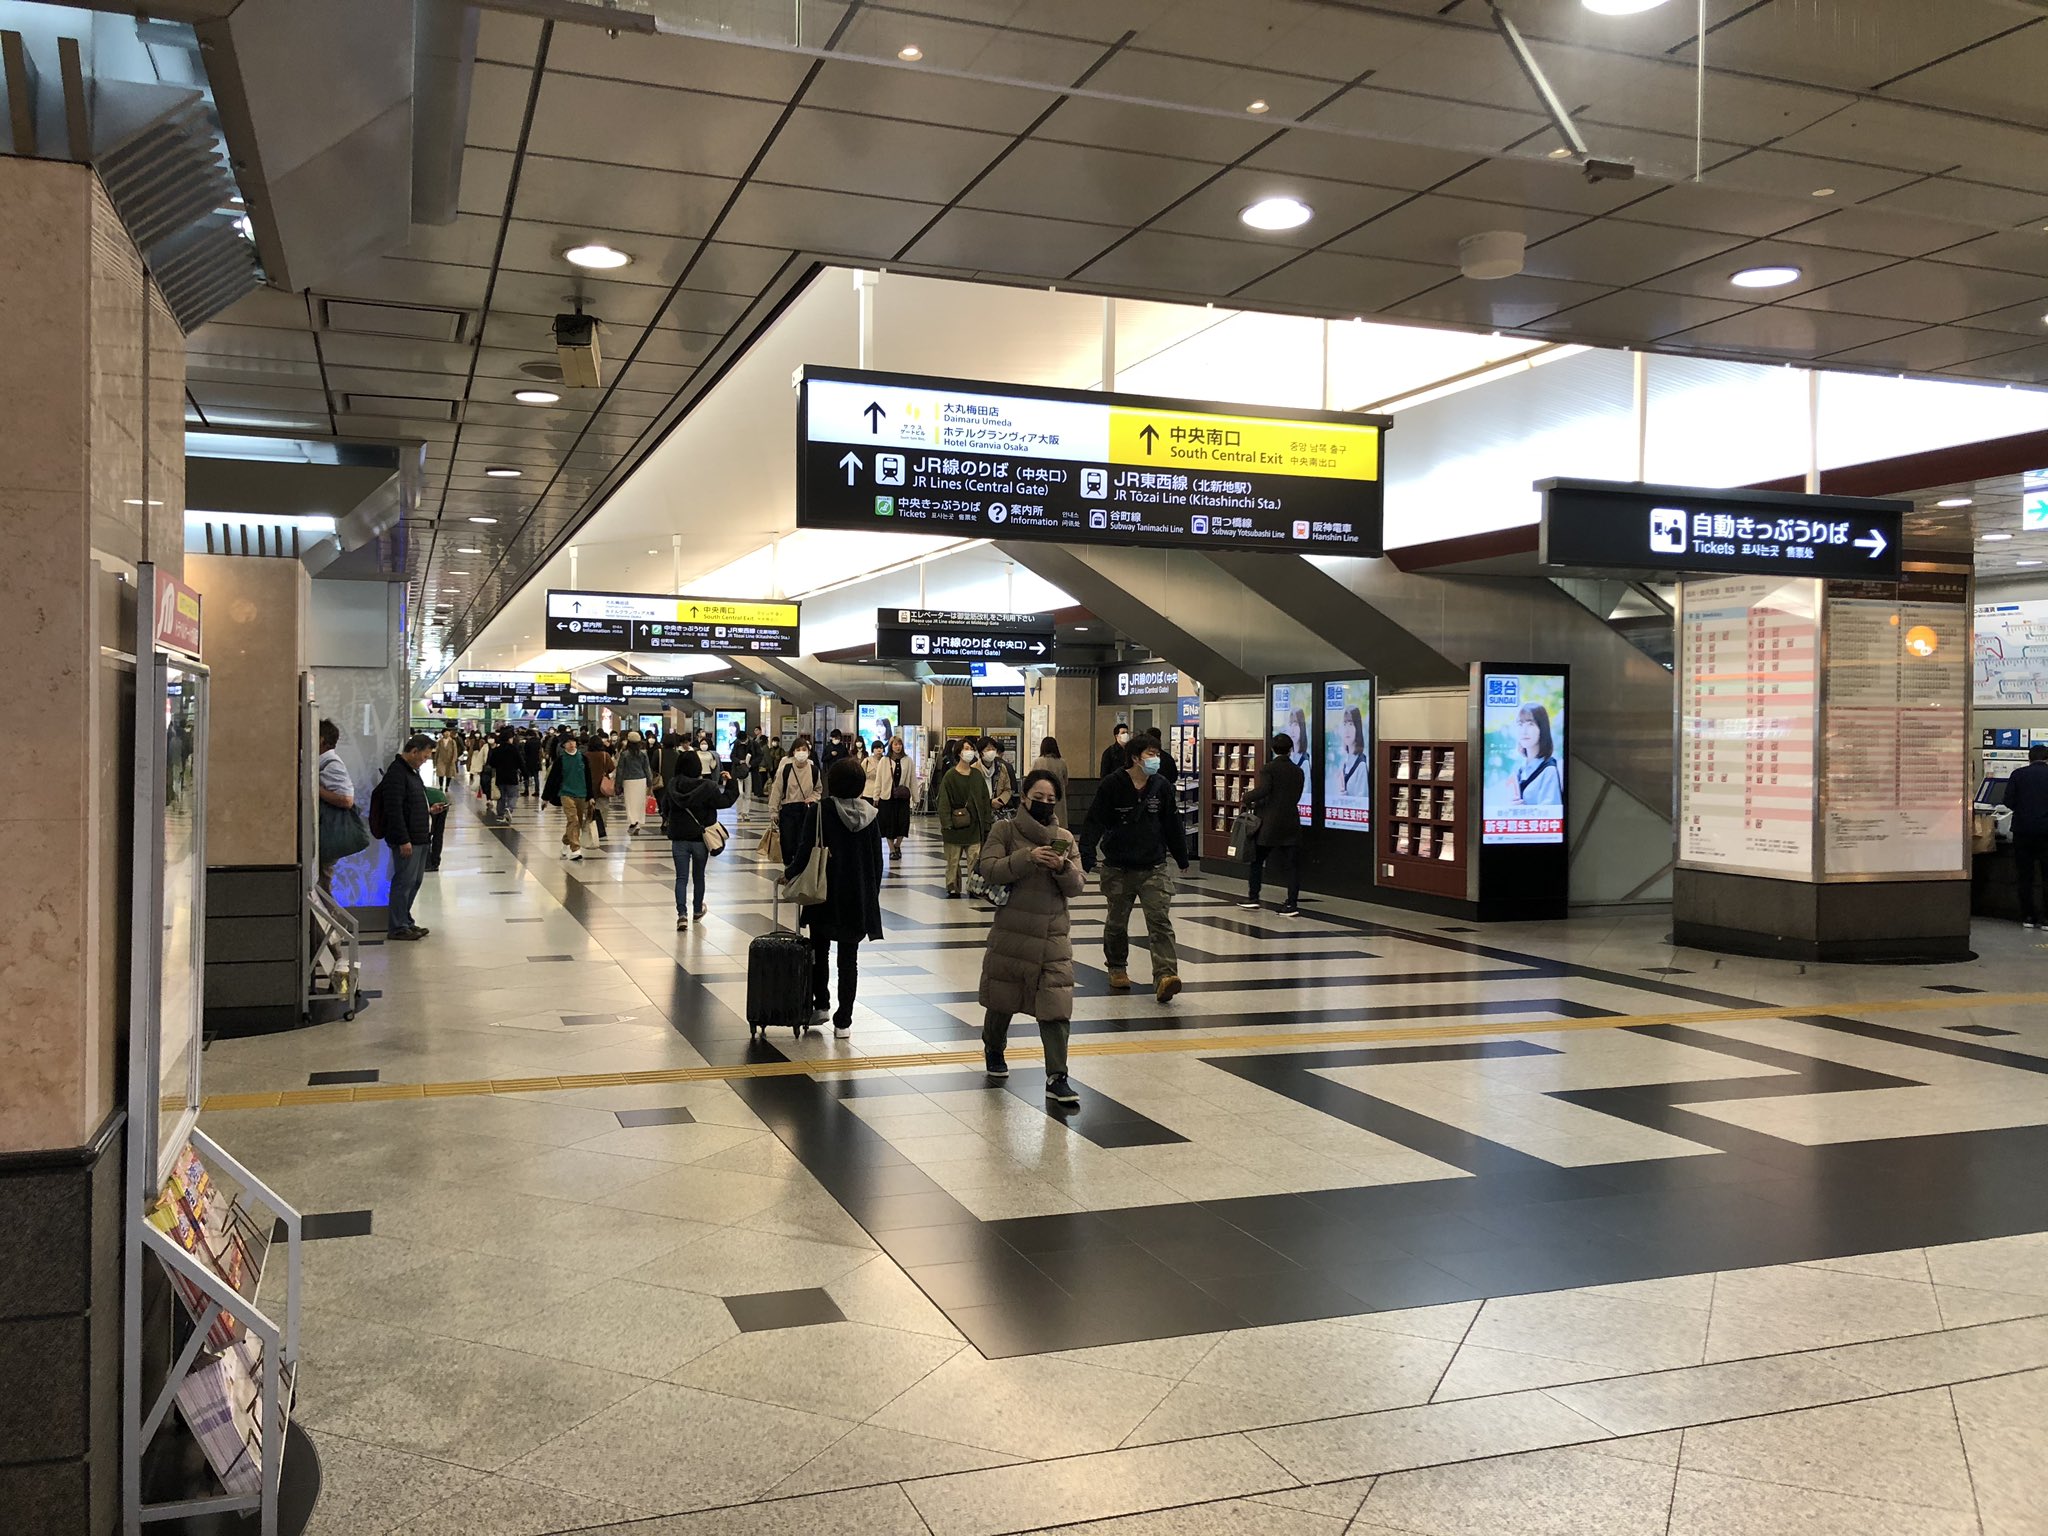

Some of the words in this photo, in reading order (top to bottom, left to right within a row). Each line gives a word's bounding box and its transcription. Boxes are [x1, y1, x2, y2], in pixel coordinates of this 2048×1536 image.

[944, 403, 1000, 417] 大丸梅田店
[944, 414, 980, 424] Daimaru
[982, 416, 1012, 427] Umeda
[944, 427, 1059, 445] ホテルグランヴィア大阪
[1170, 426, 1240, 446] 中央南口
[944, 439, 967, 448] Hotel
[969, 440, 1001, 450] Granvia
[1003, 443, 1029, 452] Osaka
[1170, 446, 1208, 460] South
[1211, 449, 1256, 463] Central
[1260, 452, 1283, 464] Exit
[1290, 457, 1336, 468] 中央南出口
[913, 476, 926, 487] JR
[931, 476, 962, 490] Lines
[965, 479, 1012, 494] (Central
[1016, 483, 1049, 496] Gate)
[1114, 472, 1252, 495] JR東西線（北新地駅）
[898, 498, 981, 512] 中央きっぷうりば
[1114, 490, 1127, 501] JR
[1130, 490, 1159, 503] Tōzai
[1162, 492, 1186, 505] Line
[1189, 494, 1255, 509] (Kitashinchi
[1257, 498, 1282, 511] Sta.)
[898, 509, 926, 519] Tickets
[1010, 504, 1044, 517] 案内所
[1110, 511, 1141, 523] 谷町線
[1011, 516, 1058, 527] Information
[1110, 522, 1135, 532] Subway
[1137, 523, 1168, 533] Tanimachi
[1170, 524, 1184, 533] Line
[1211, 517, 1252, 528] 四つ橋線
[1312, 522, 1352, 534] 阪神電車
[1693, 512, 1849, 544] 自動きっぷうりば
[1211, 527, 1236, 538] Subway
[1238, 529, 1271, 538] Yotsubashi
[1272, 530, 1285, 539] Line
[1312, 533, 1342, 541] Hanshin
[1343, 534, 1359, 543] Line
[1692, 540, 1735, 555] Tickets
[1741, 543, 1780, 557] 표사는곳
[1489, 680, 1516, 696] 駿台
